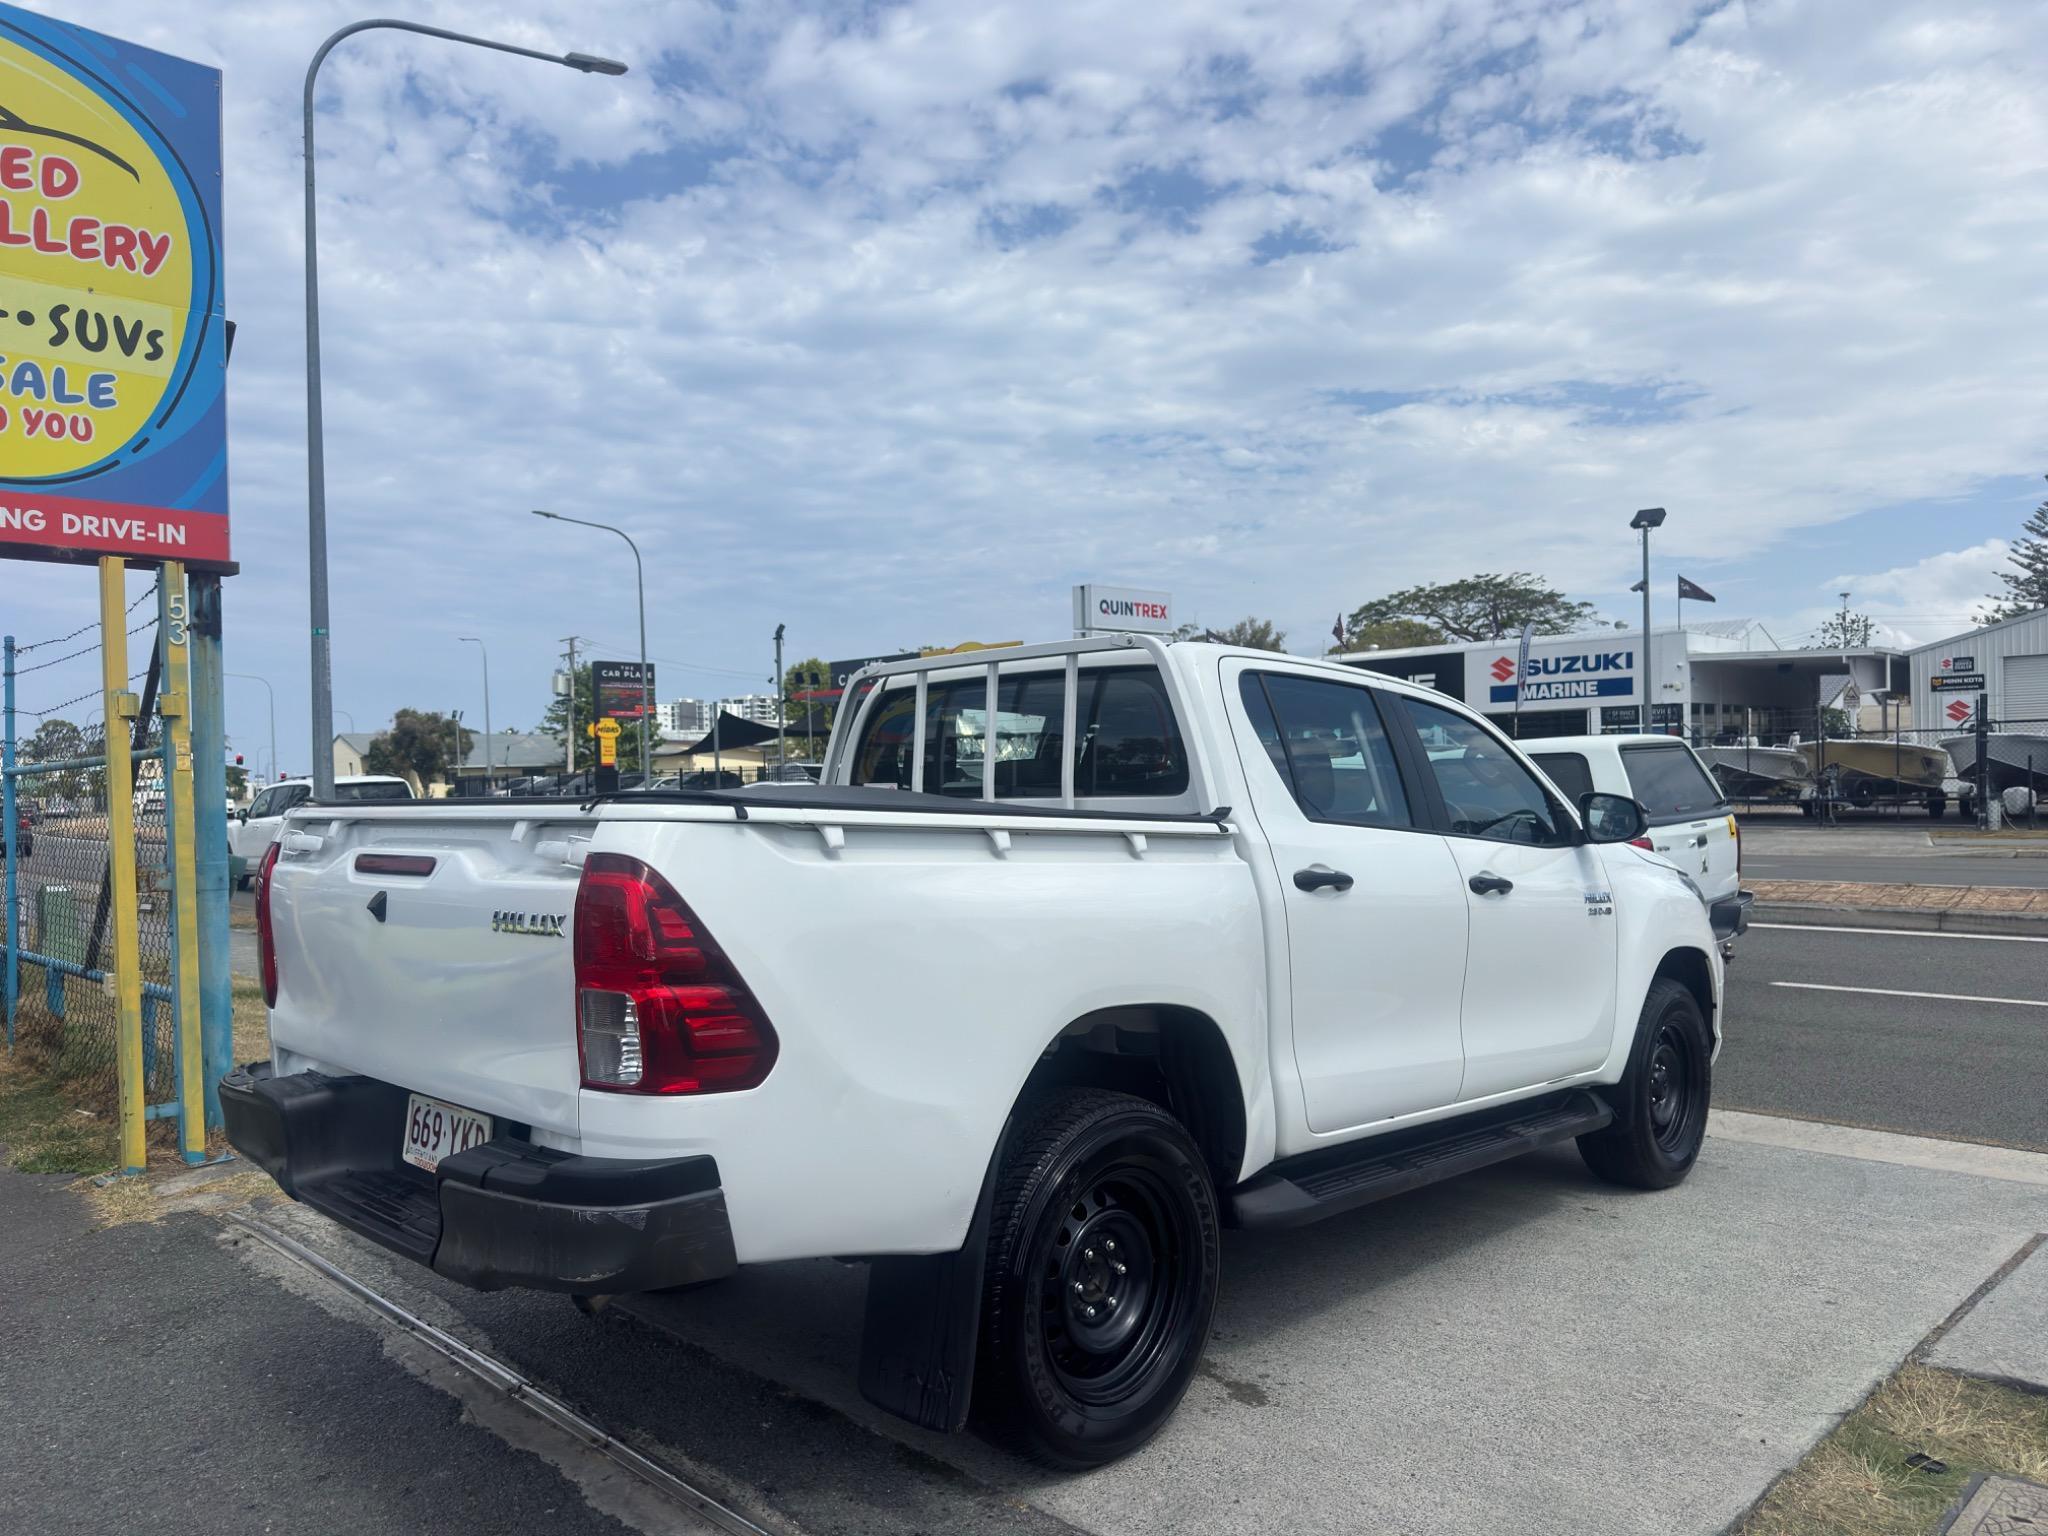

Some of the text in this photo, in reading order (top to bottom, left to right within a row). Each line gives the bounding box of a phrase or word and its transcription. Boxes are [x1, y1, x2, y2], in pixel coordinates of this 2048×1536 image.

[0, 146, 79, 198] ED
[22, 407, 93, 442] YOU
[0, 506, 186, 545] NG DRIVE-IN
[1099, 599, 1167, 619] QUINTREX
[601, 669, 653, 679] CAR PLAE
[1526, 651, 1633, 677] SUZUKI
[1523, 680, 1599, 700] MARINE
[492, 909, 567, 937] HILUX
